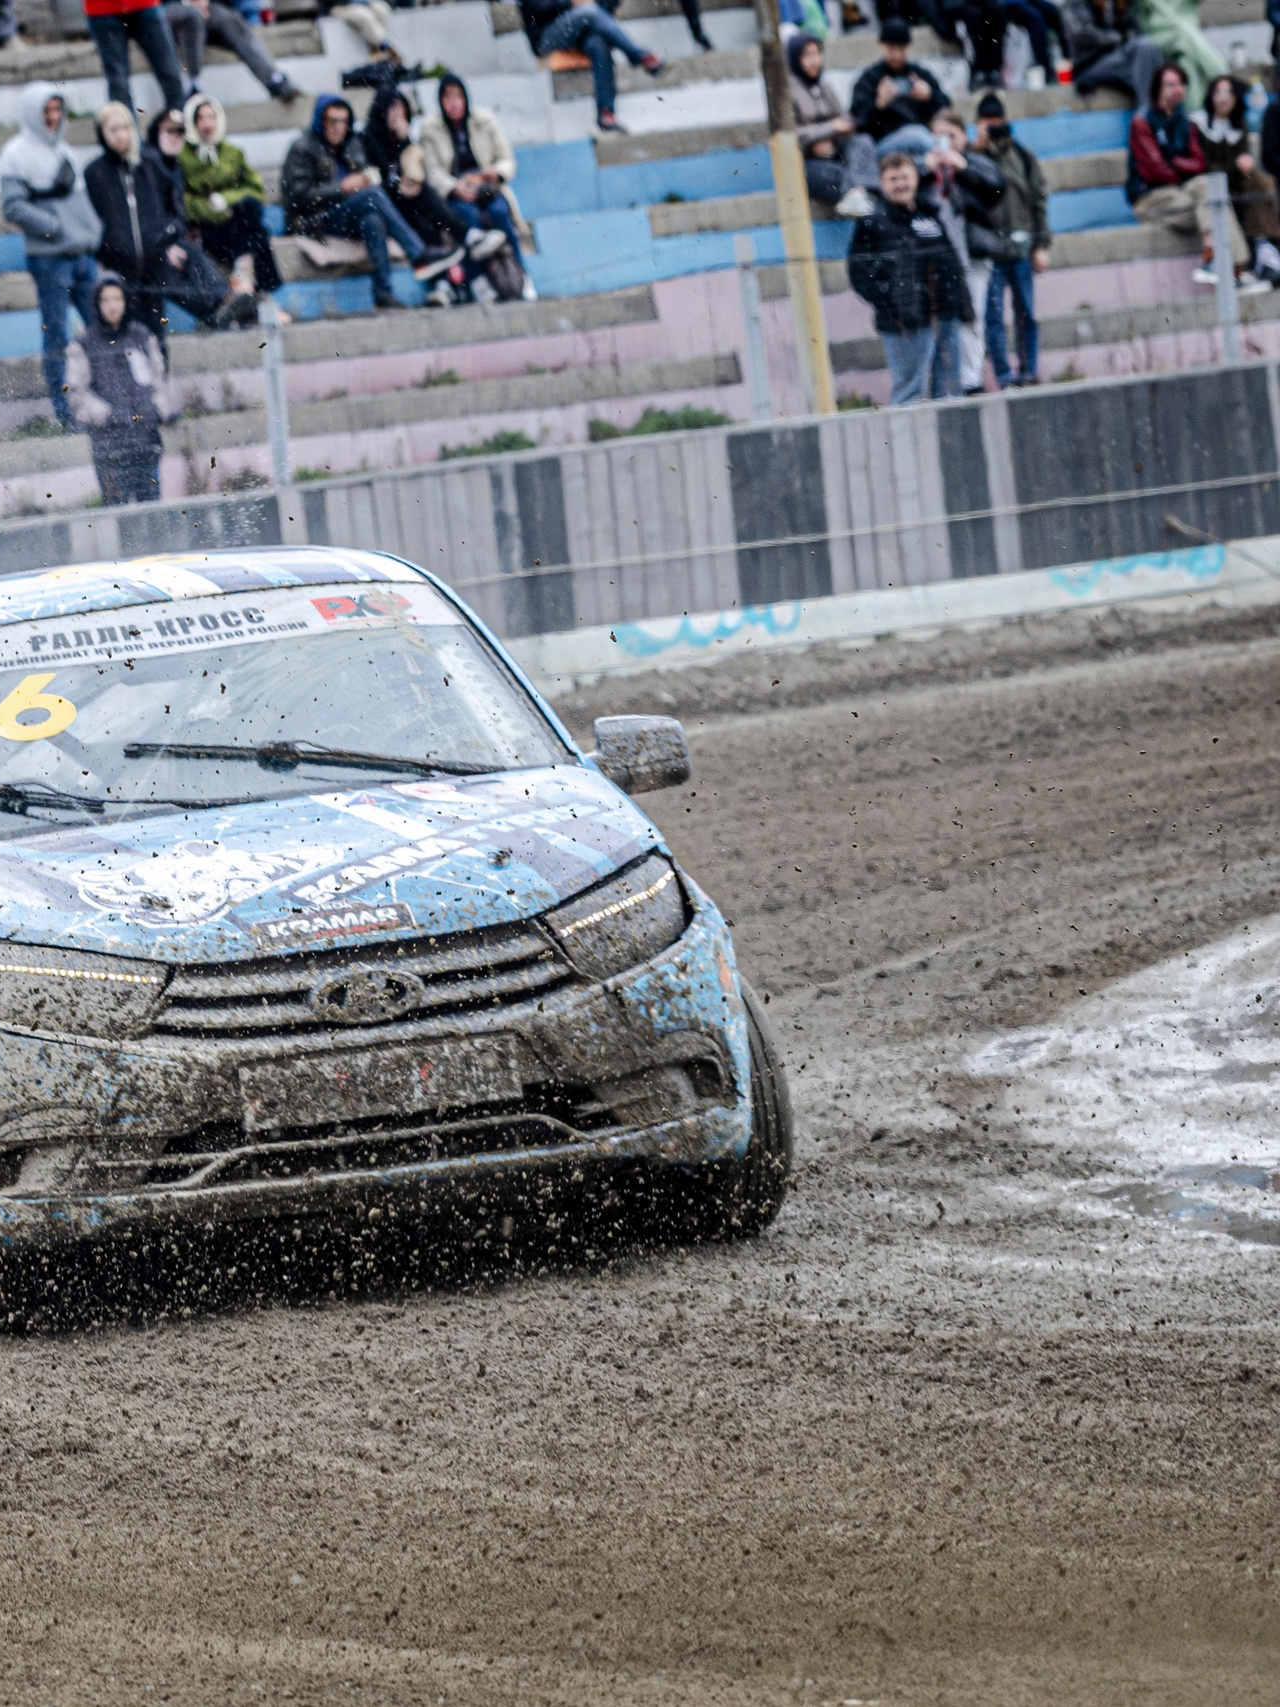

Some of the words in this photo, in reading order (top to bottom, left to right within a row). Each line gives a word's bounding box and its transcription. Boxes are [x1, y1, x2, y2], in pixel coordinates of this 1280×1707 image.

[30, 606, 266, 652] РАЛЛИ-КРОСС
[247, 620, 309, 636] РОССИИ
[266, 906, 399, 939] KRAMAR
